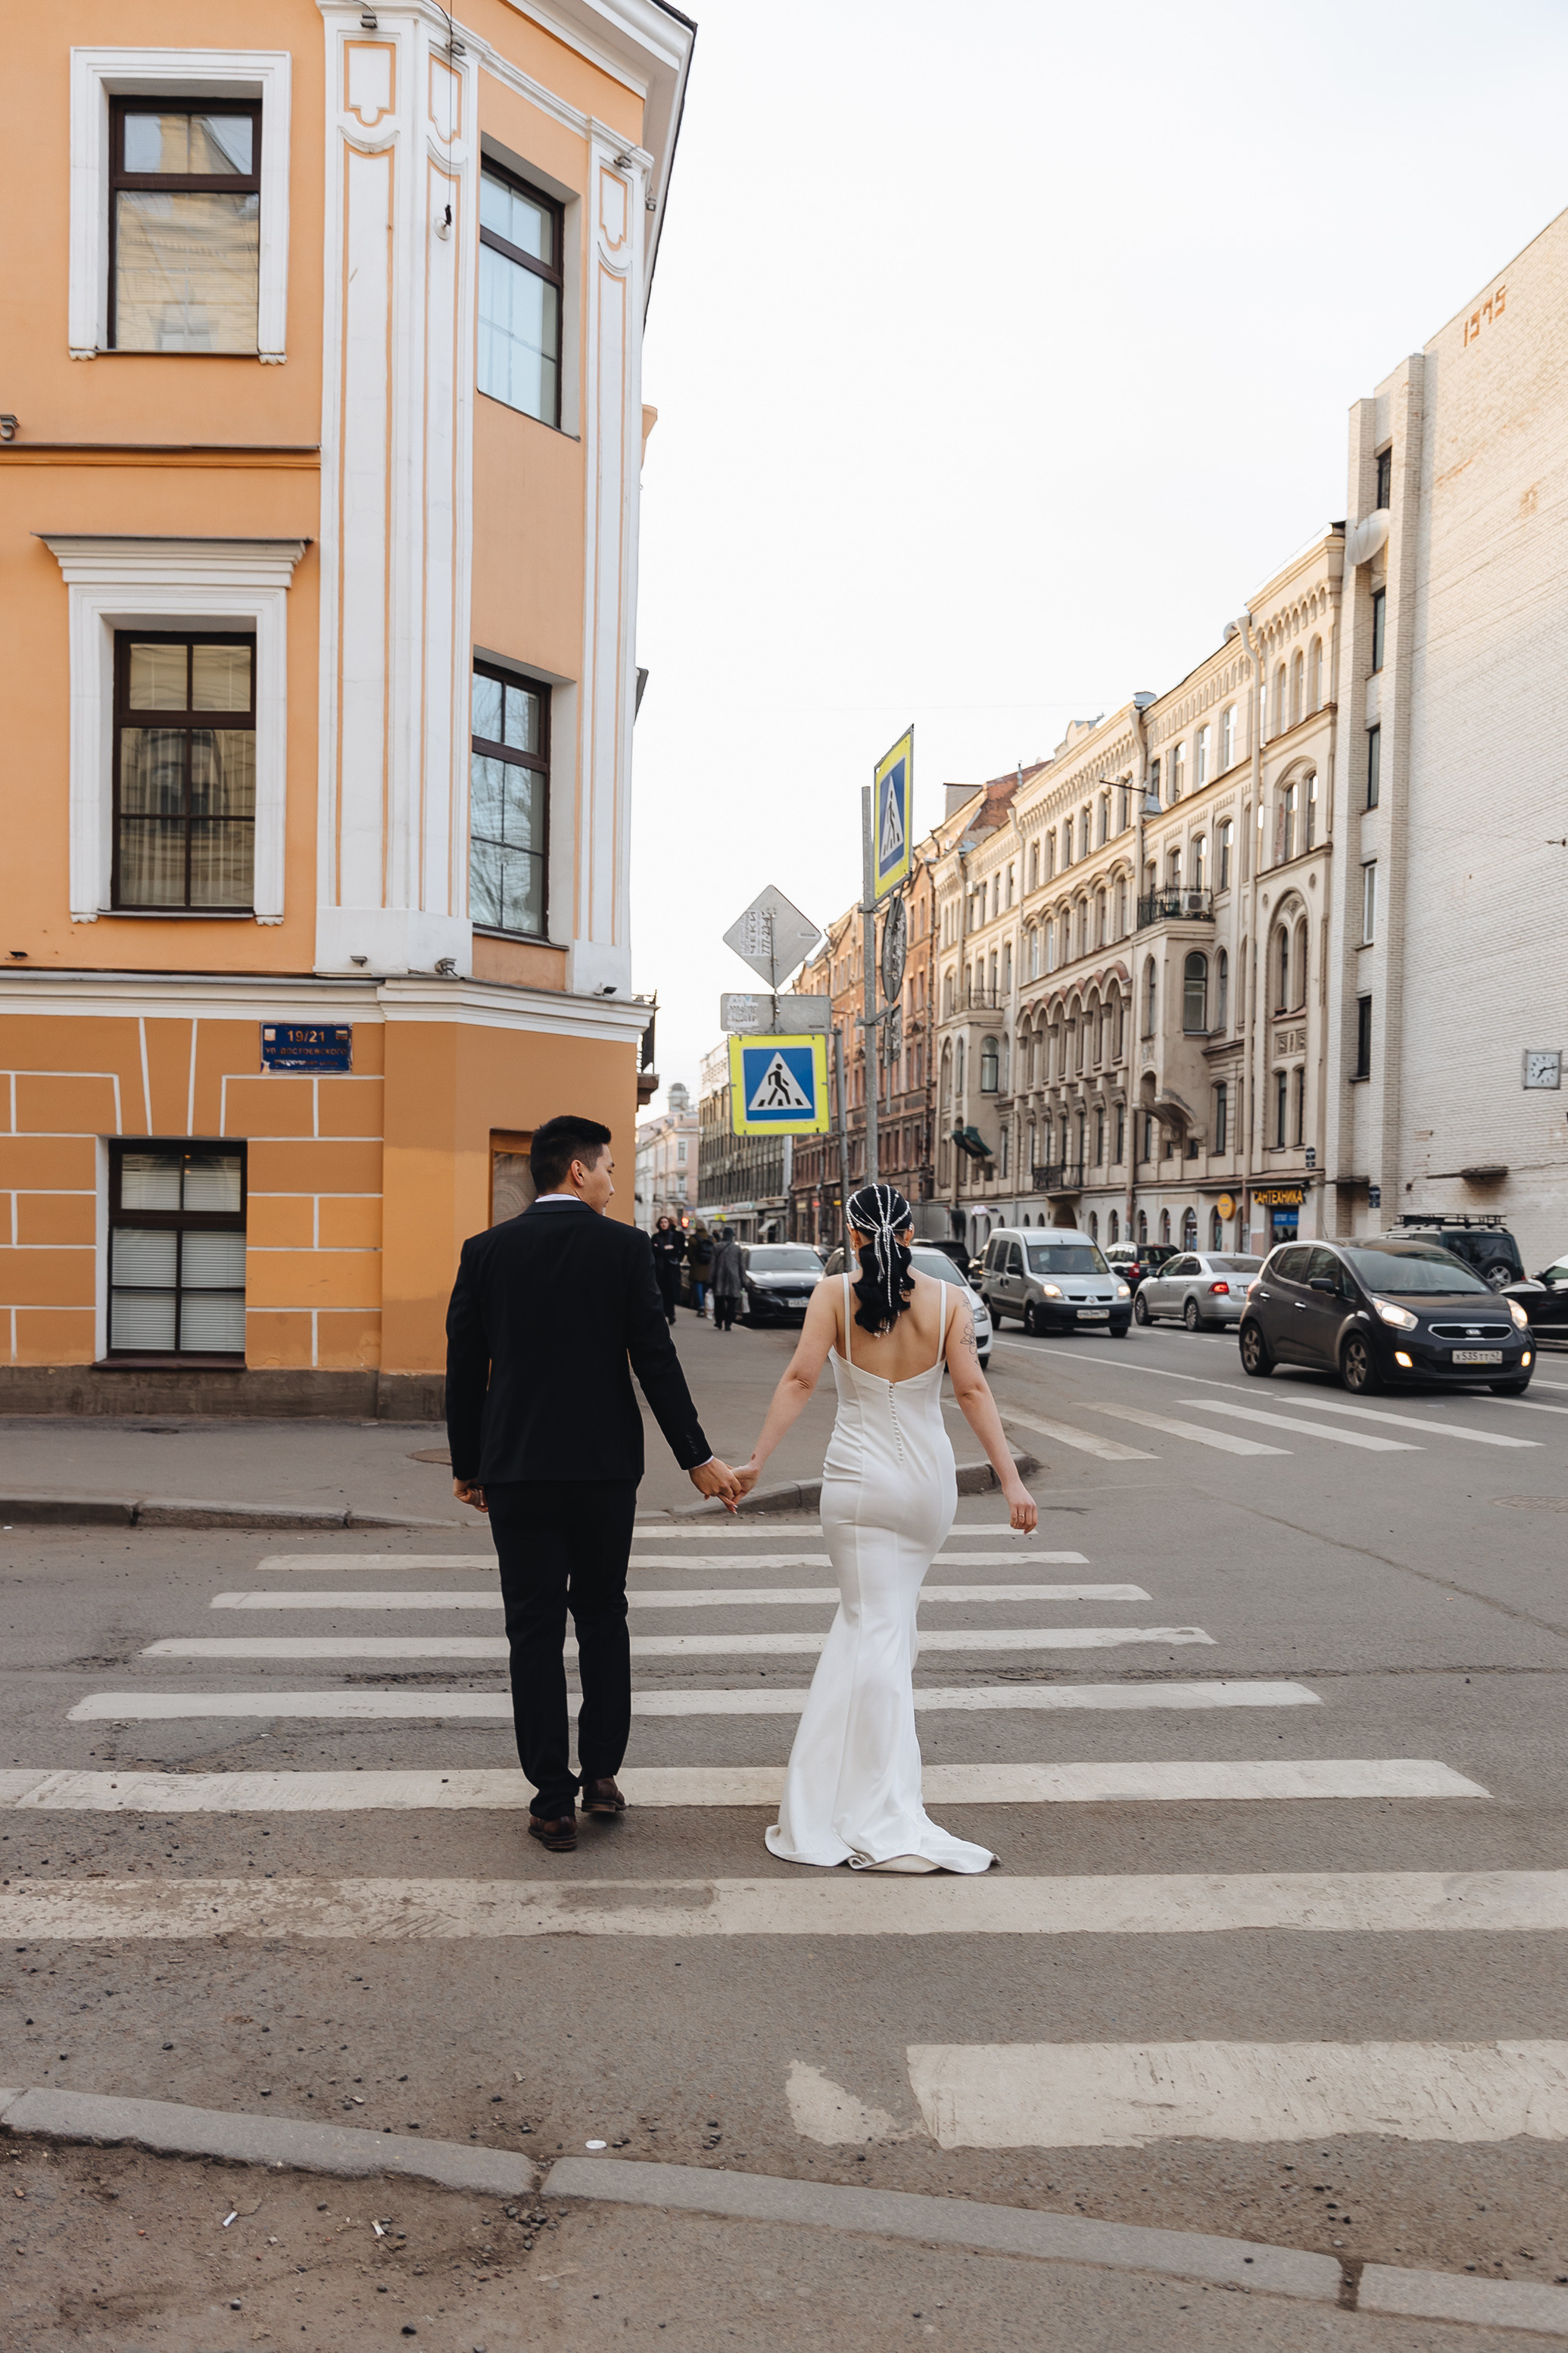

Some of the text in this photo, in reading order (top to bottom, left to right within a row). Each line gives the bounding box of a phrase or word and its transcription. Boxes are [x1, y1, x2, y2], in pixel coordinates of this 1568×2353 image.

[1464, 285, 1506, 347] 1975
[288, 1031, 325, 1043] 19/21
[1253, 1190, 1303, 1205] САНТЕХНИКА
